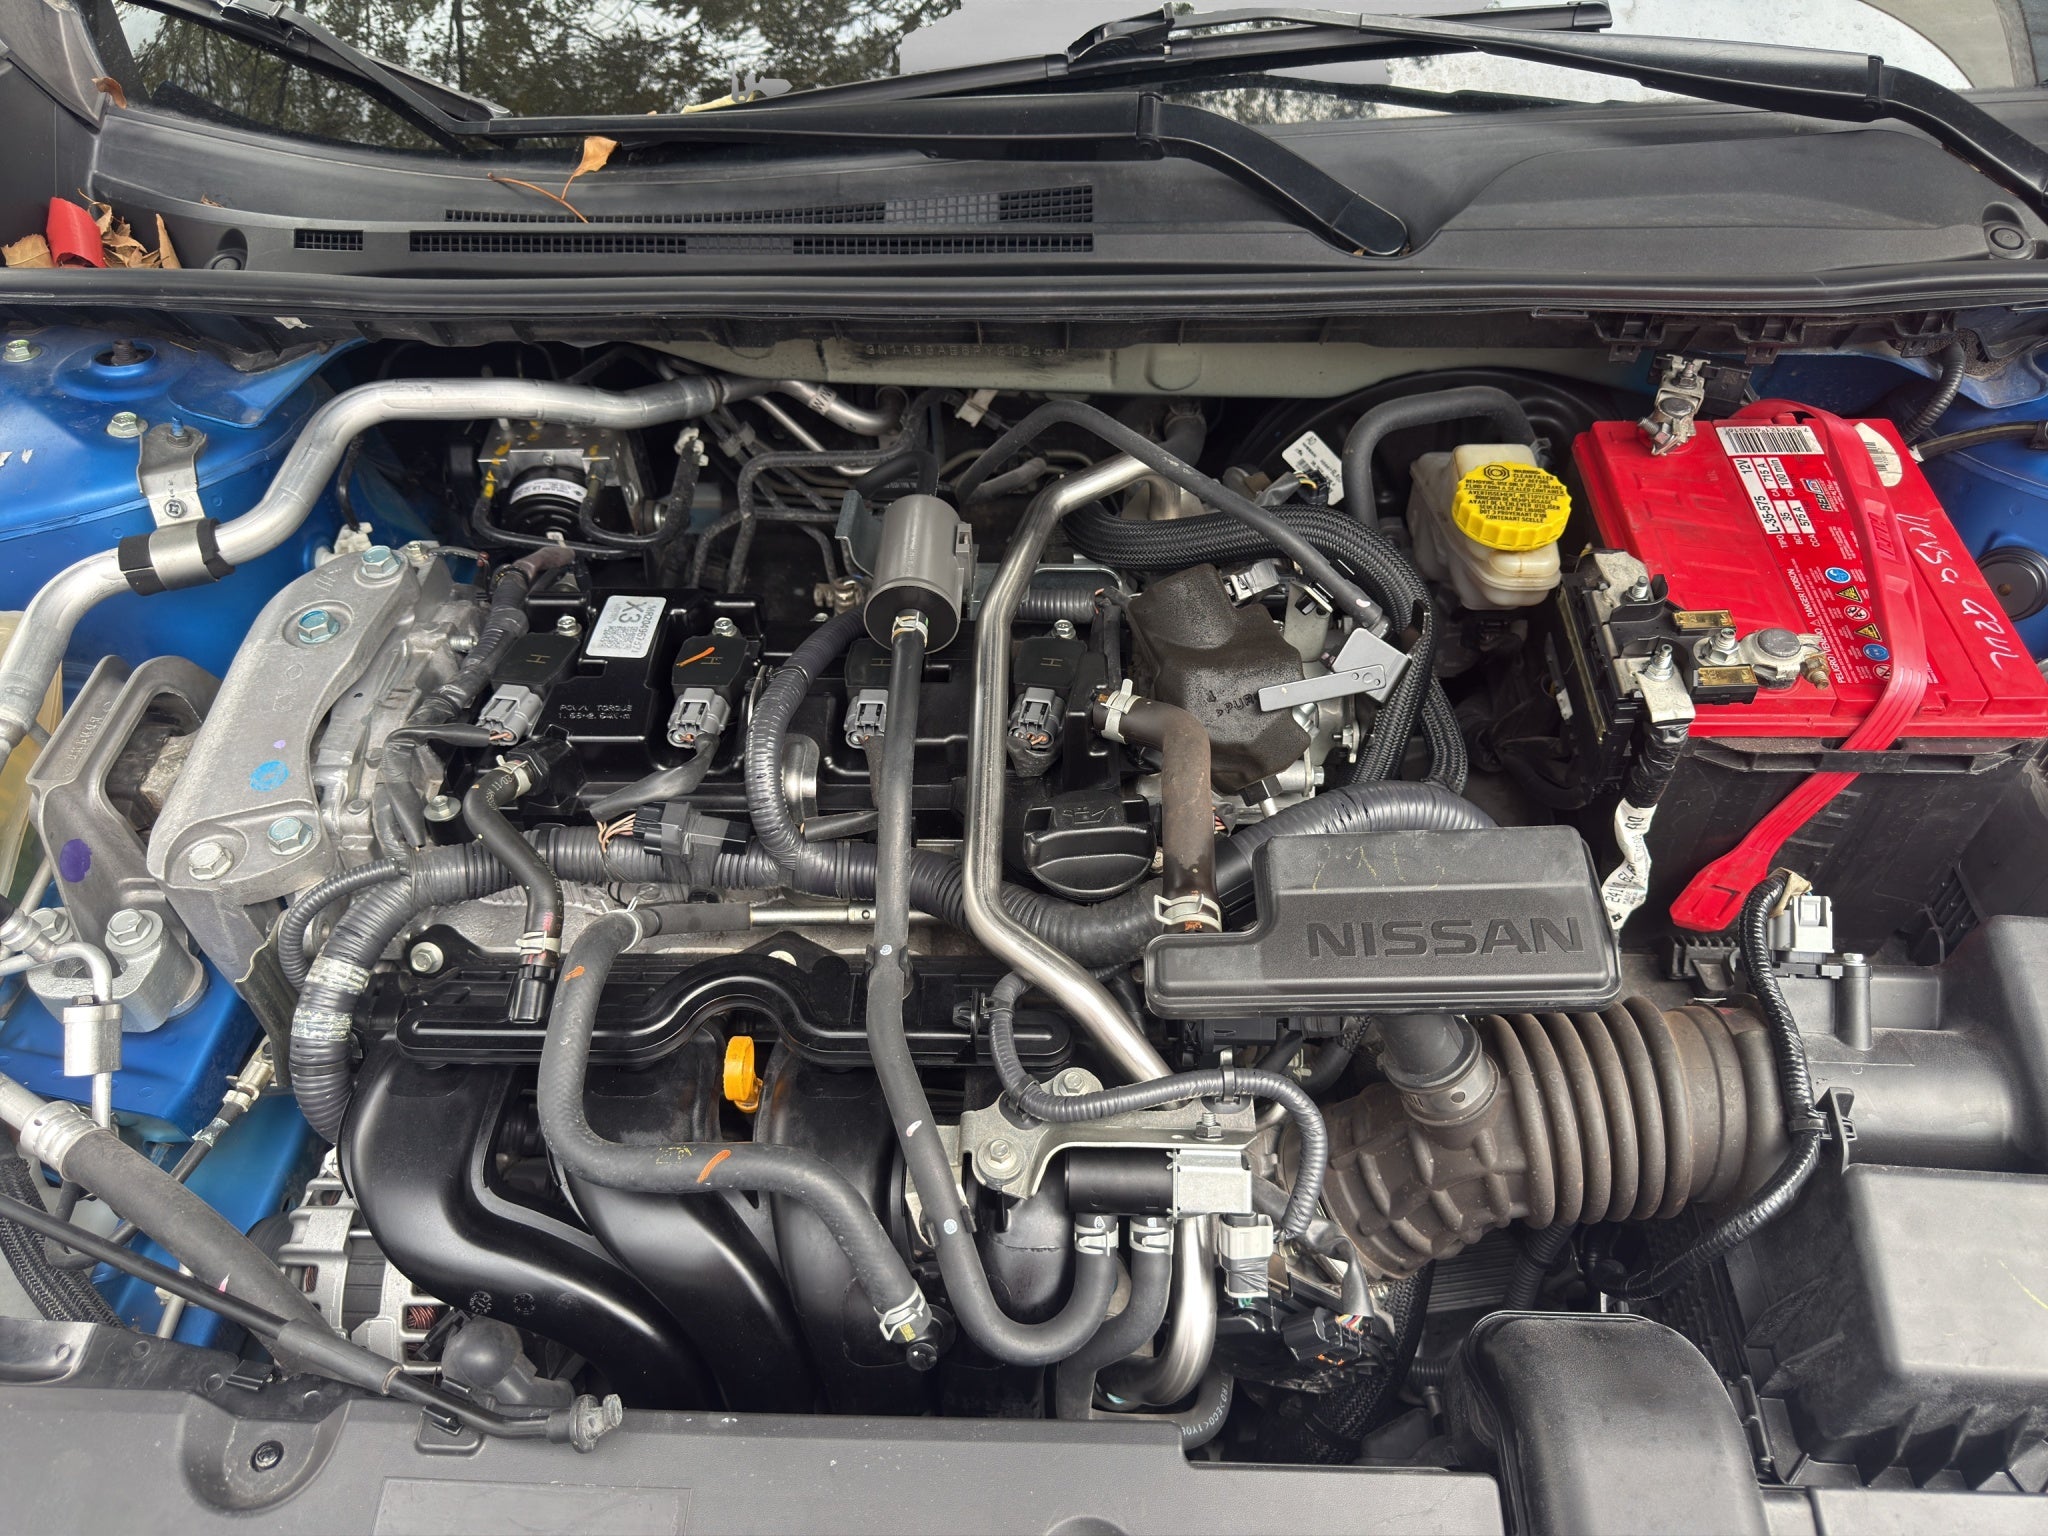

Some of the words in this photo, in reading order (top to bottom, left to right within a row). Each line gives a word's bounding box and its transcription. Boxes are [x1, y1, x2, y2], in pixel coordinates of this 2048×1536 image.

[1736, 459, 1753, 474] 12V
[1771, 459, 1783, 472] min
[1760, 470, 1773, 483] 715
[1776, 473, 1790, 486] 100
[1815, 493, 1832, 511] RED
[1752, 495, 1781, 533] L-35-575
[1780, 512, 1792, 522] 35
[1796, 513, 1810, 527] 575
[1776, 534, 1788, 548] TIPO
[1792, 534, 1804, 545] BCI
[1808, 534, 1820, 547] CCA
[1787, 568, 1802, 591] POISON
[618, 600, 646, 623] X3
[1798, 593, 1815, 618] DANGER
[1827, 656, 1846, 684] PELIGRO
[1307, 916, 1584, 959] NISSAN
